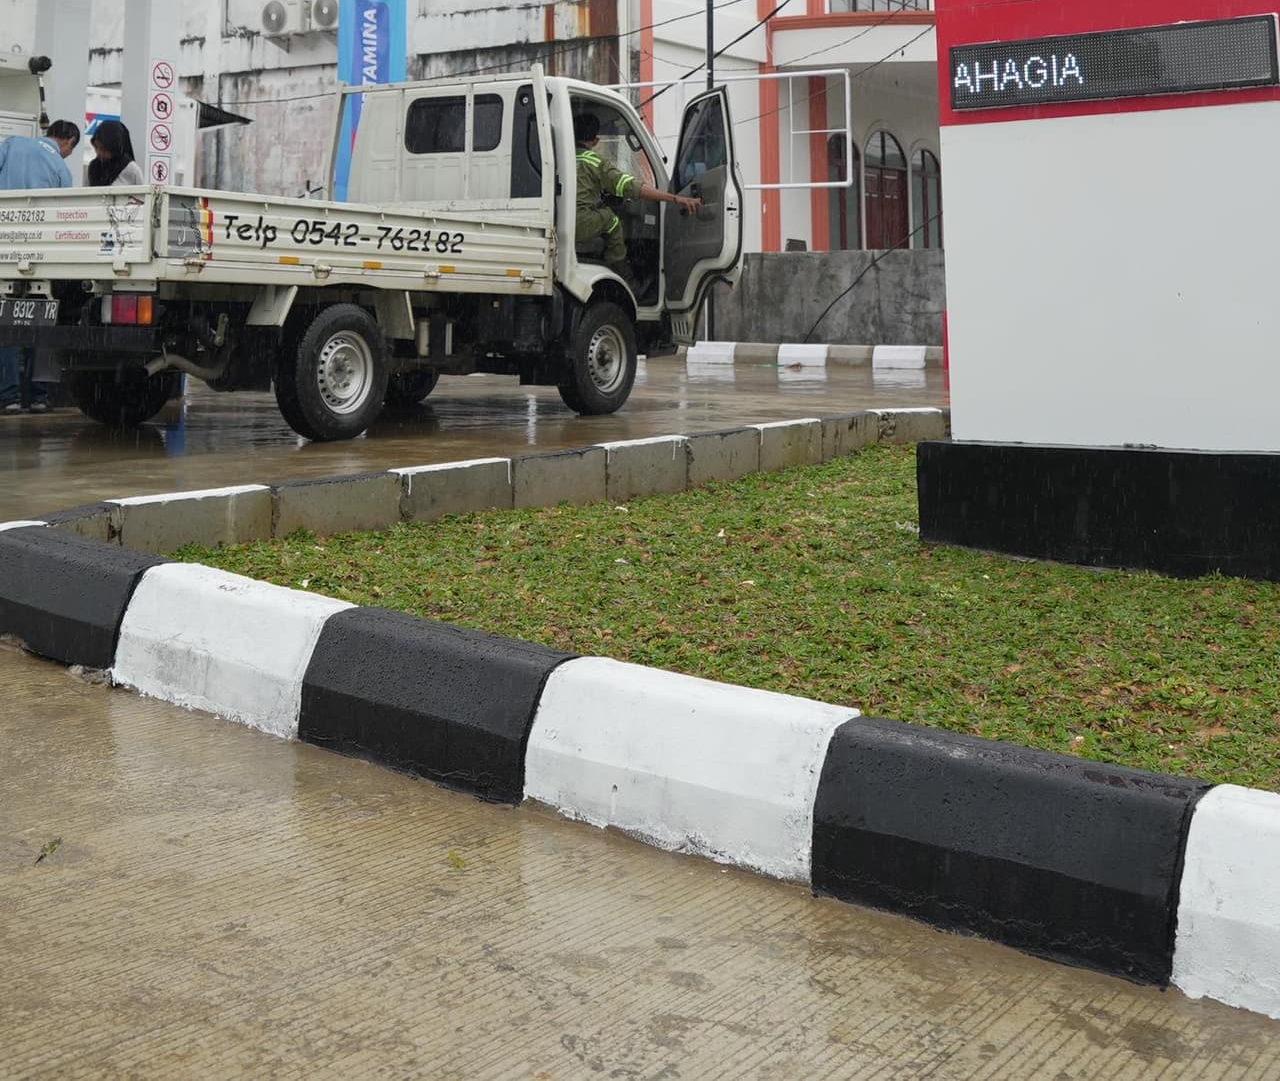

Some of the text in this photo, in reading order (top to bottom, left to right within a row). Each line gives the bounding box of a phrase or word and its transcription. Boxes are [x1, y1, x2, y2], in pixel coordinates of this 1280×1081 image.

[361, 8, 377, 103] TAMINA
[954, 53, 1084, 93] AHAGIA
[56, 211, 88, 221] Inspection
[54, 231, 90, 240] Certification
[223, 216, 465, 254] Telp 0542-762182
[13, 301, 35, 318] 8312
[44, 302, 57, 319] YR
